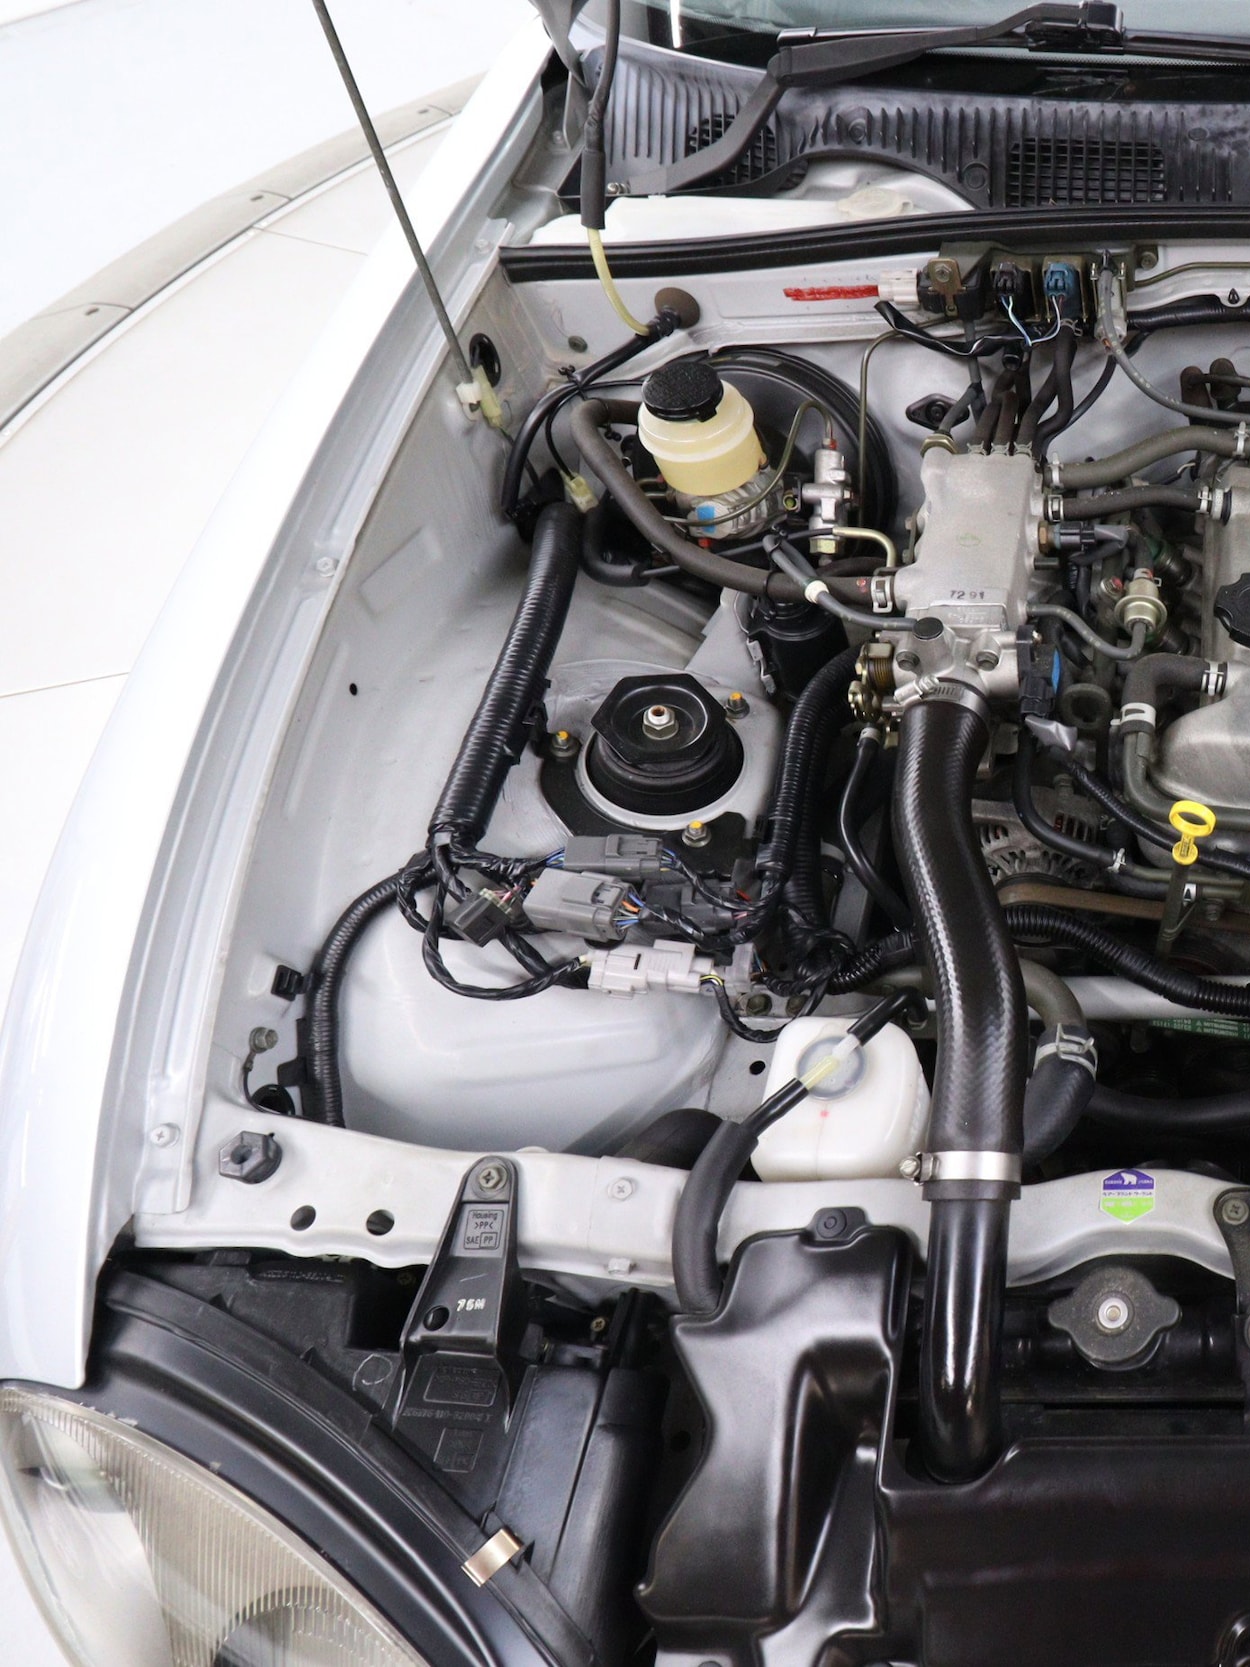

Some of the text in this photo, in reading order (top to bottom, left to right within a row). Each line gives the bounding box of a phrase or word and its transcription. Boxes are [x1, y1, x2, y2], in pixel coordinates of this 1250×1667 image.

[472, 1211, 498, 1221] Housing
[466, 1235, 493, 1245] SAE PP
